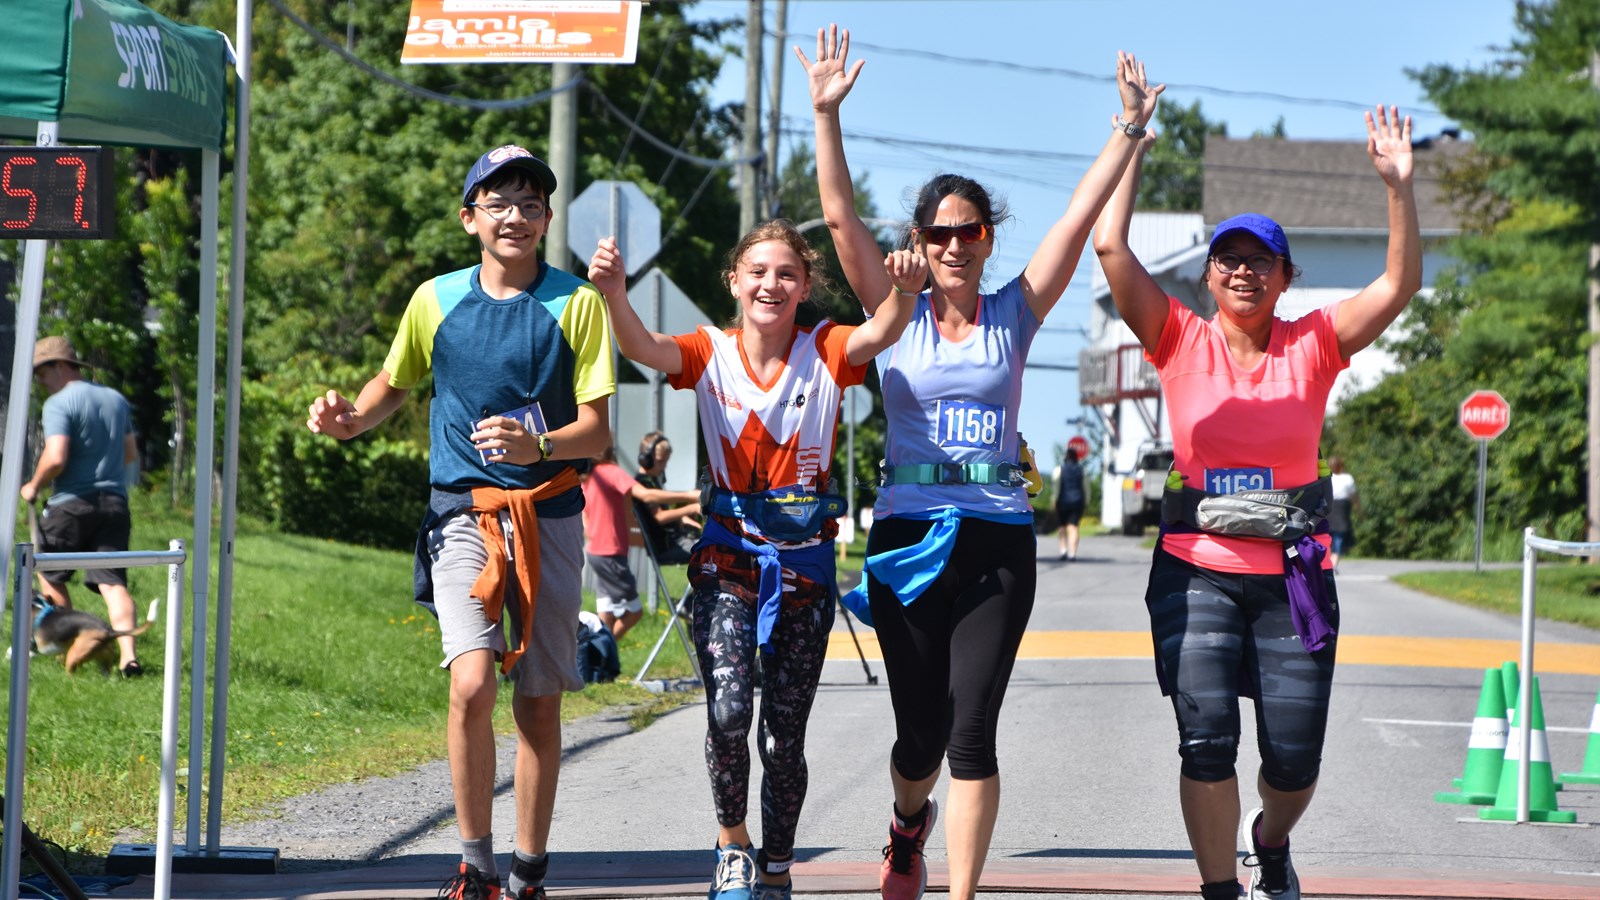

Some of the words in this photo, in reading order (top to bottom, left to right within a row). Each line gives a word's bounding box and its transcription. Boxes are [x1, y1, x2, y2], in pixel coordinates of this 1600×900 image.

[407, 15, 549, 31] Jamie
[1464, 404, 1507, 425] ARRÊT
[944, 407, 997, 445] 1158
